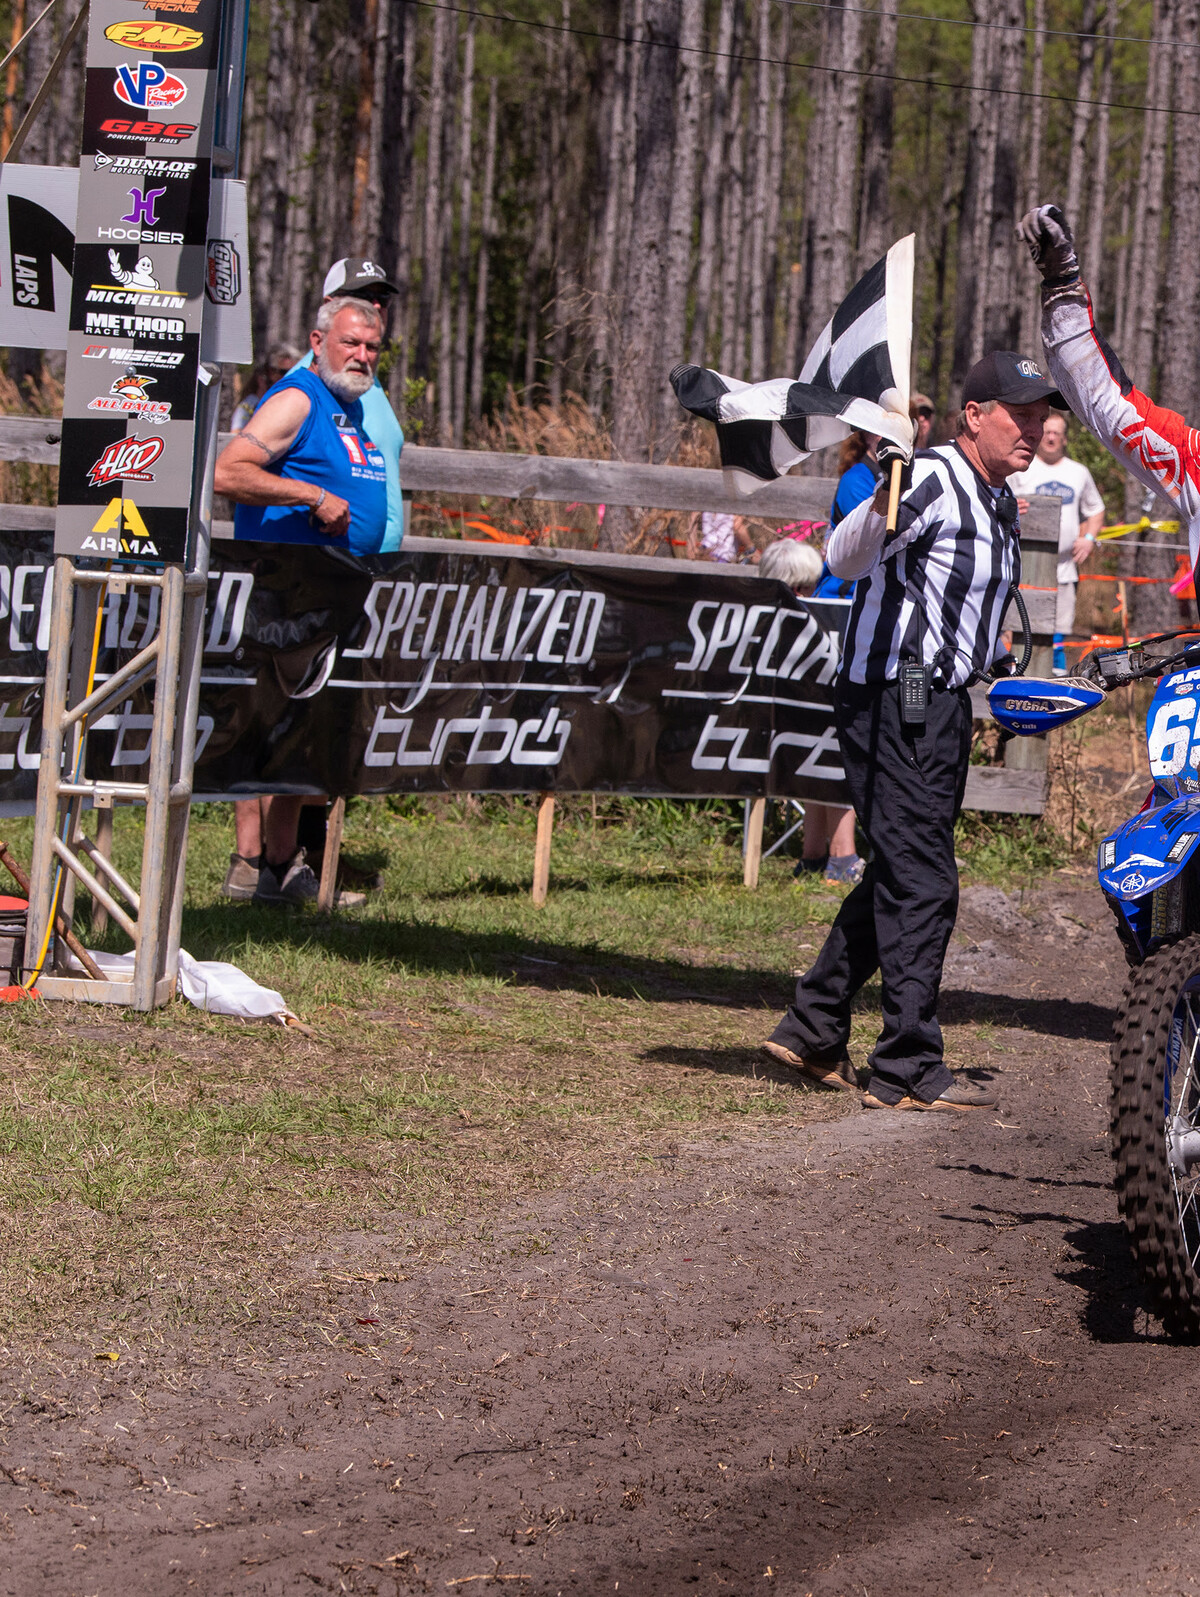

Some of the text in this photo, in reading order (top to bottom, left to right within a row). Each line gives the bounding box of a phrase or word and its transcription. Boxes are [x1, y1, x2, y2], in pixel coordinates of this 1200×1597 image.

[143, 2, 198, 13] RACING
[107, 25, 203, 46] FMF
[117, 62, 166, 107] VP
[149, 87, 188, 99] Racing
[100, 119, 197, 138] GBC
[107, 133, 155, 142] POWERSPORTS
[111, 167, 190, 179] MOTORCYCLE TIRES
[114, 157, 197, 172] DUNLOP
[98, 227, 184, 244] HOOSIER
[14, 253, 39, 306] LAPS
[85, 290, 186, 309] MICHELIN
[86, 312, 184, 334] METHOD
[86, 326, 183, 341] RACE WHEELS
[108, 347, 185, 365] WISECO
[89, 399, 168, 413] ALL BALLS
[81, 536, 159, 555] ARMA
[341, 581, 606, 663] SPECIALIZED
[1005, 698, 1050, 712] CYCRA
[364, 705, 572, 767] turbo
[691, 715, 846, 780] turb
